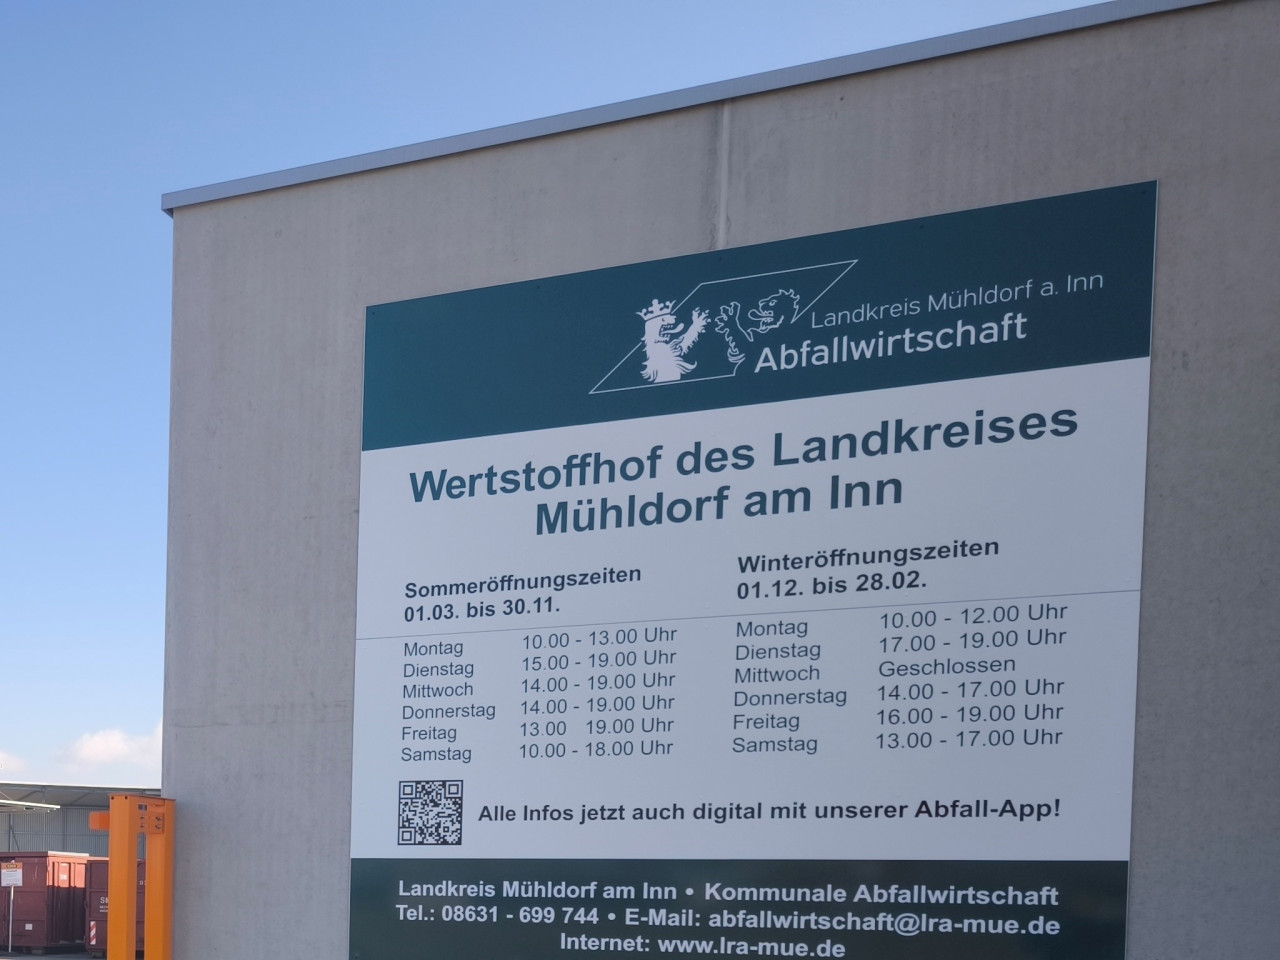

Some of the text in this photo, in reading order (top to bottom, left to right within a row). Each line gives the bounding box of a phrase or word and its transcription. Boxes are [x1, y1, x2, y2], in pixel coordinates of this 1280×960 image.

[811, 274, 1103, 328] Landkreis Mühldorf a. Inn
[754, 312, 1027, 373] Abfallwirtschaft
[409, 409, 1078, 502] Wertstoffhof des Landkreises
[536, 474, 902, 535] Mühldorf am Inn
[737, 539, 999, 573] Winteröffnungszeiten
[405, 567, 641, 598] Sommeröffnungszeiten
[737, 570, 926, 599] 01.12. bis 28.02.
[404, 596, 559, 622] 01.03. bis 30.11.
[736, 620, 808, 638] Montag
[880, 610, 936, 629] 10.00
[961, 605, 1019, 624] 12.00
[1028, 603, 1068, 620] Uhr
[404, 641, 463, 657] Montag
[523, 632, 569, 649] 10.00
[589, 628, 637, 645] 13.00
[644, 626, 677, 642] Uhr
[735, 642, 821, 661] Dienstag
[879, 634, 935, 653] 17.00
[960, 630, 1018, 649] 19.00
[1027, 628, 1067, 645] Uhr
[403, 661, 474, 678] Dienstag
[522, 654, 569, 671] 15.00
[588, 650, 637, 668] 19.00
[644, 649, 677, 665] Uhr
[734, 658, 1015, 683] Mittwoch Geschlossen
[402, 681, 473, 698] Mittwoch
[521, 676, 568, 693] 14.00
[588, 673, 636, 690] 19.00
[643, 671, 675, 688] Uhr
[734, 688, 847, 707] Donnerstag
[878, 683, 934, 701] 14.00
[958, 679, 1016, 698] 17.00
[1025, 678, 1065, 695] Uhr
[402, 703, 495, 720] Donnerstag
[520, 698, 567, 715] 14.00
[587, 695, 635, 712] 19.00
[642, 694, 675, 710] Uhr
[733, 713, 800, 732] Freitag
[877, 707, 933, 725] 16.00
[957, 704, 1015, 722] 19.00
[1024, 703, 1064, 720] Uhr
[402, 717, 674, 743] Freitag 13.00 19.00 Uhr
[732, 736, 818, 755] Samstag
[876, 731, 932, 749] 13.00
[956, 729, 1014, 747] 17.00
[1023, 728, 1063, 745] Uhr
[400, 747, 471, 764] Samstag
[519, 742, 566, 758] 10.00
[585, 740, 634, 757] 18.00
[641, 739, 673, 755] Uhr
[478, 798, 1060, 825] Alle Infos jetzt auch digital mit unserer Abfall-App!
[399, 879, 1059, 905] Landkreis Mühldorf am Inn Kommunale Abfallwirtschaft
[395, 904, 434, 920] Tel.:
[441, 905, 497, 922] 08631
[519, 906, 555, 923] 699
[561, 907, 599, 924] 744
[625, 907, 700, 926] E-Mail:
[708, 909, 1060, 936] abfallwirtschaft@lra-mue.de
[560, 932, 846, 957] Internet: www.lra-mue.de
